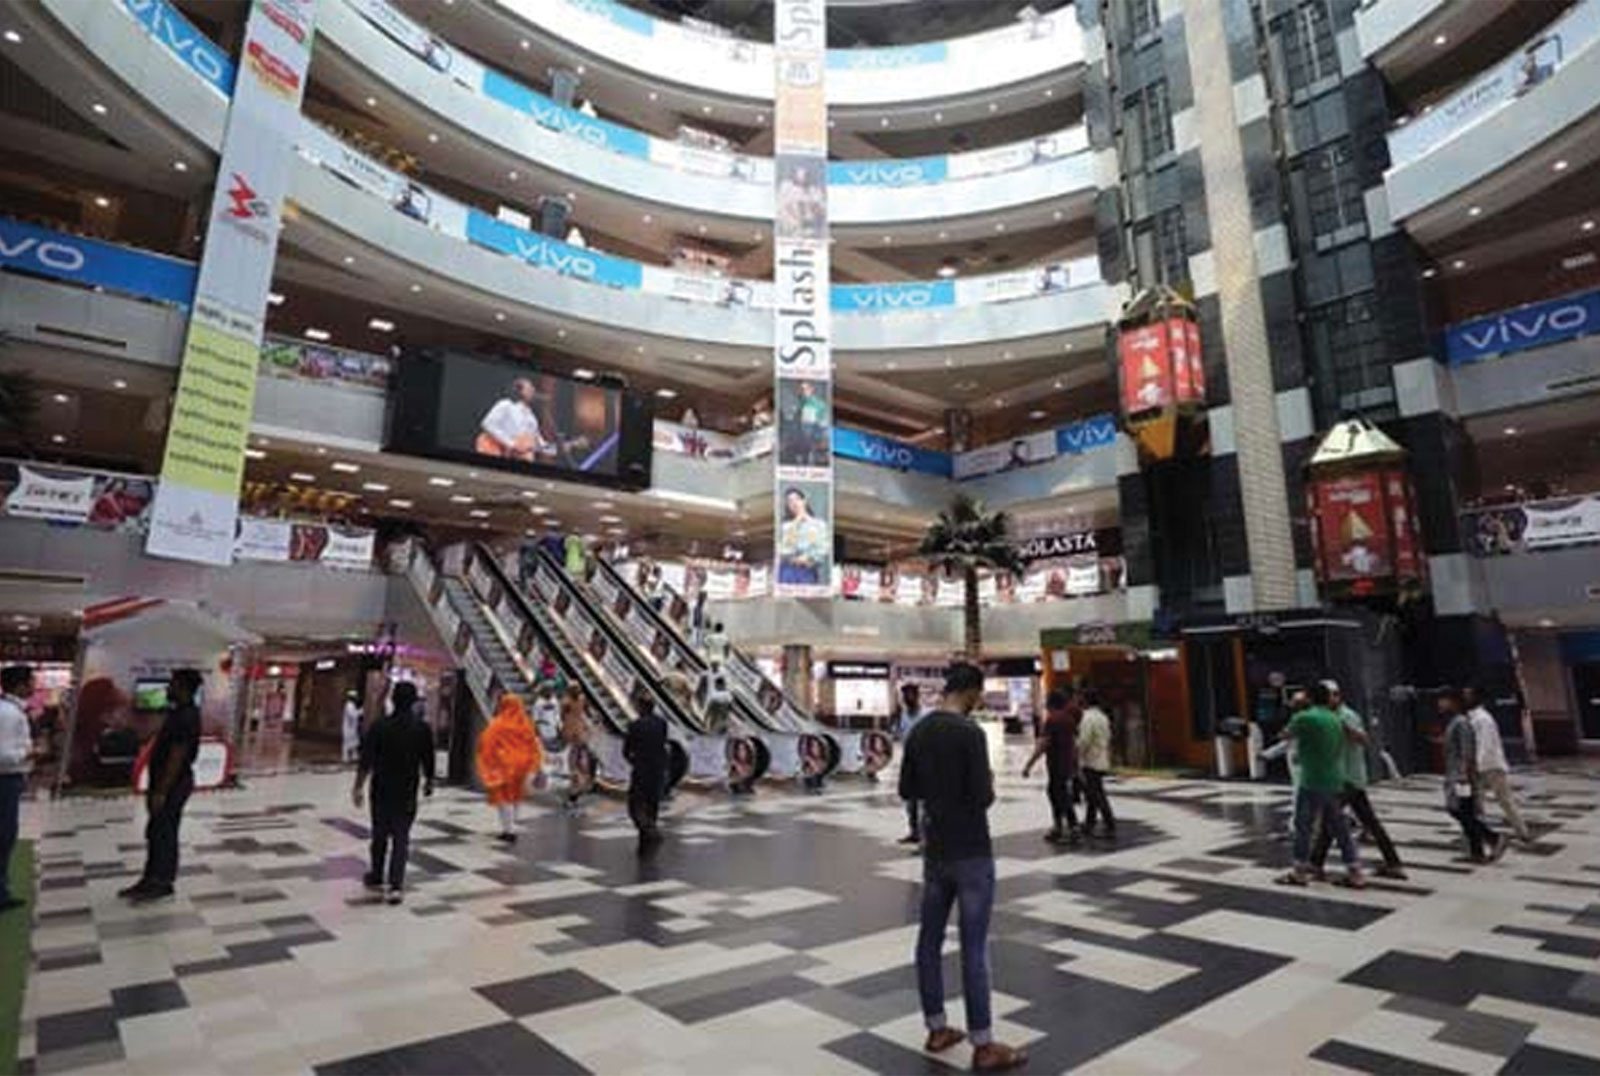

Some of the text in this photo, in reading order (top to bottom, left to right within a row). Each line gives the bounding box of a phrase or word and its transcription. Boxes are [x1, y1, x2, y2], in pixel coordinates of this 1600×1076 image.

[530, 100, 607, 145] vivo
[845, 164, 923, 183] vivo
[515, 236, 596, 275] vivo
[778, 249, 827, 366] Splash
[851, 288, 930, 306] vivo
[1460, 305, 1587, 350] vivo
[858, 439, 914, 465] vivo
